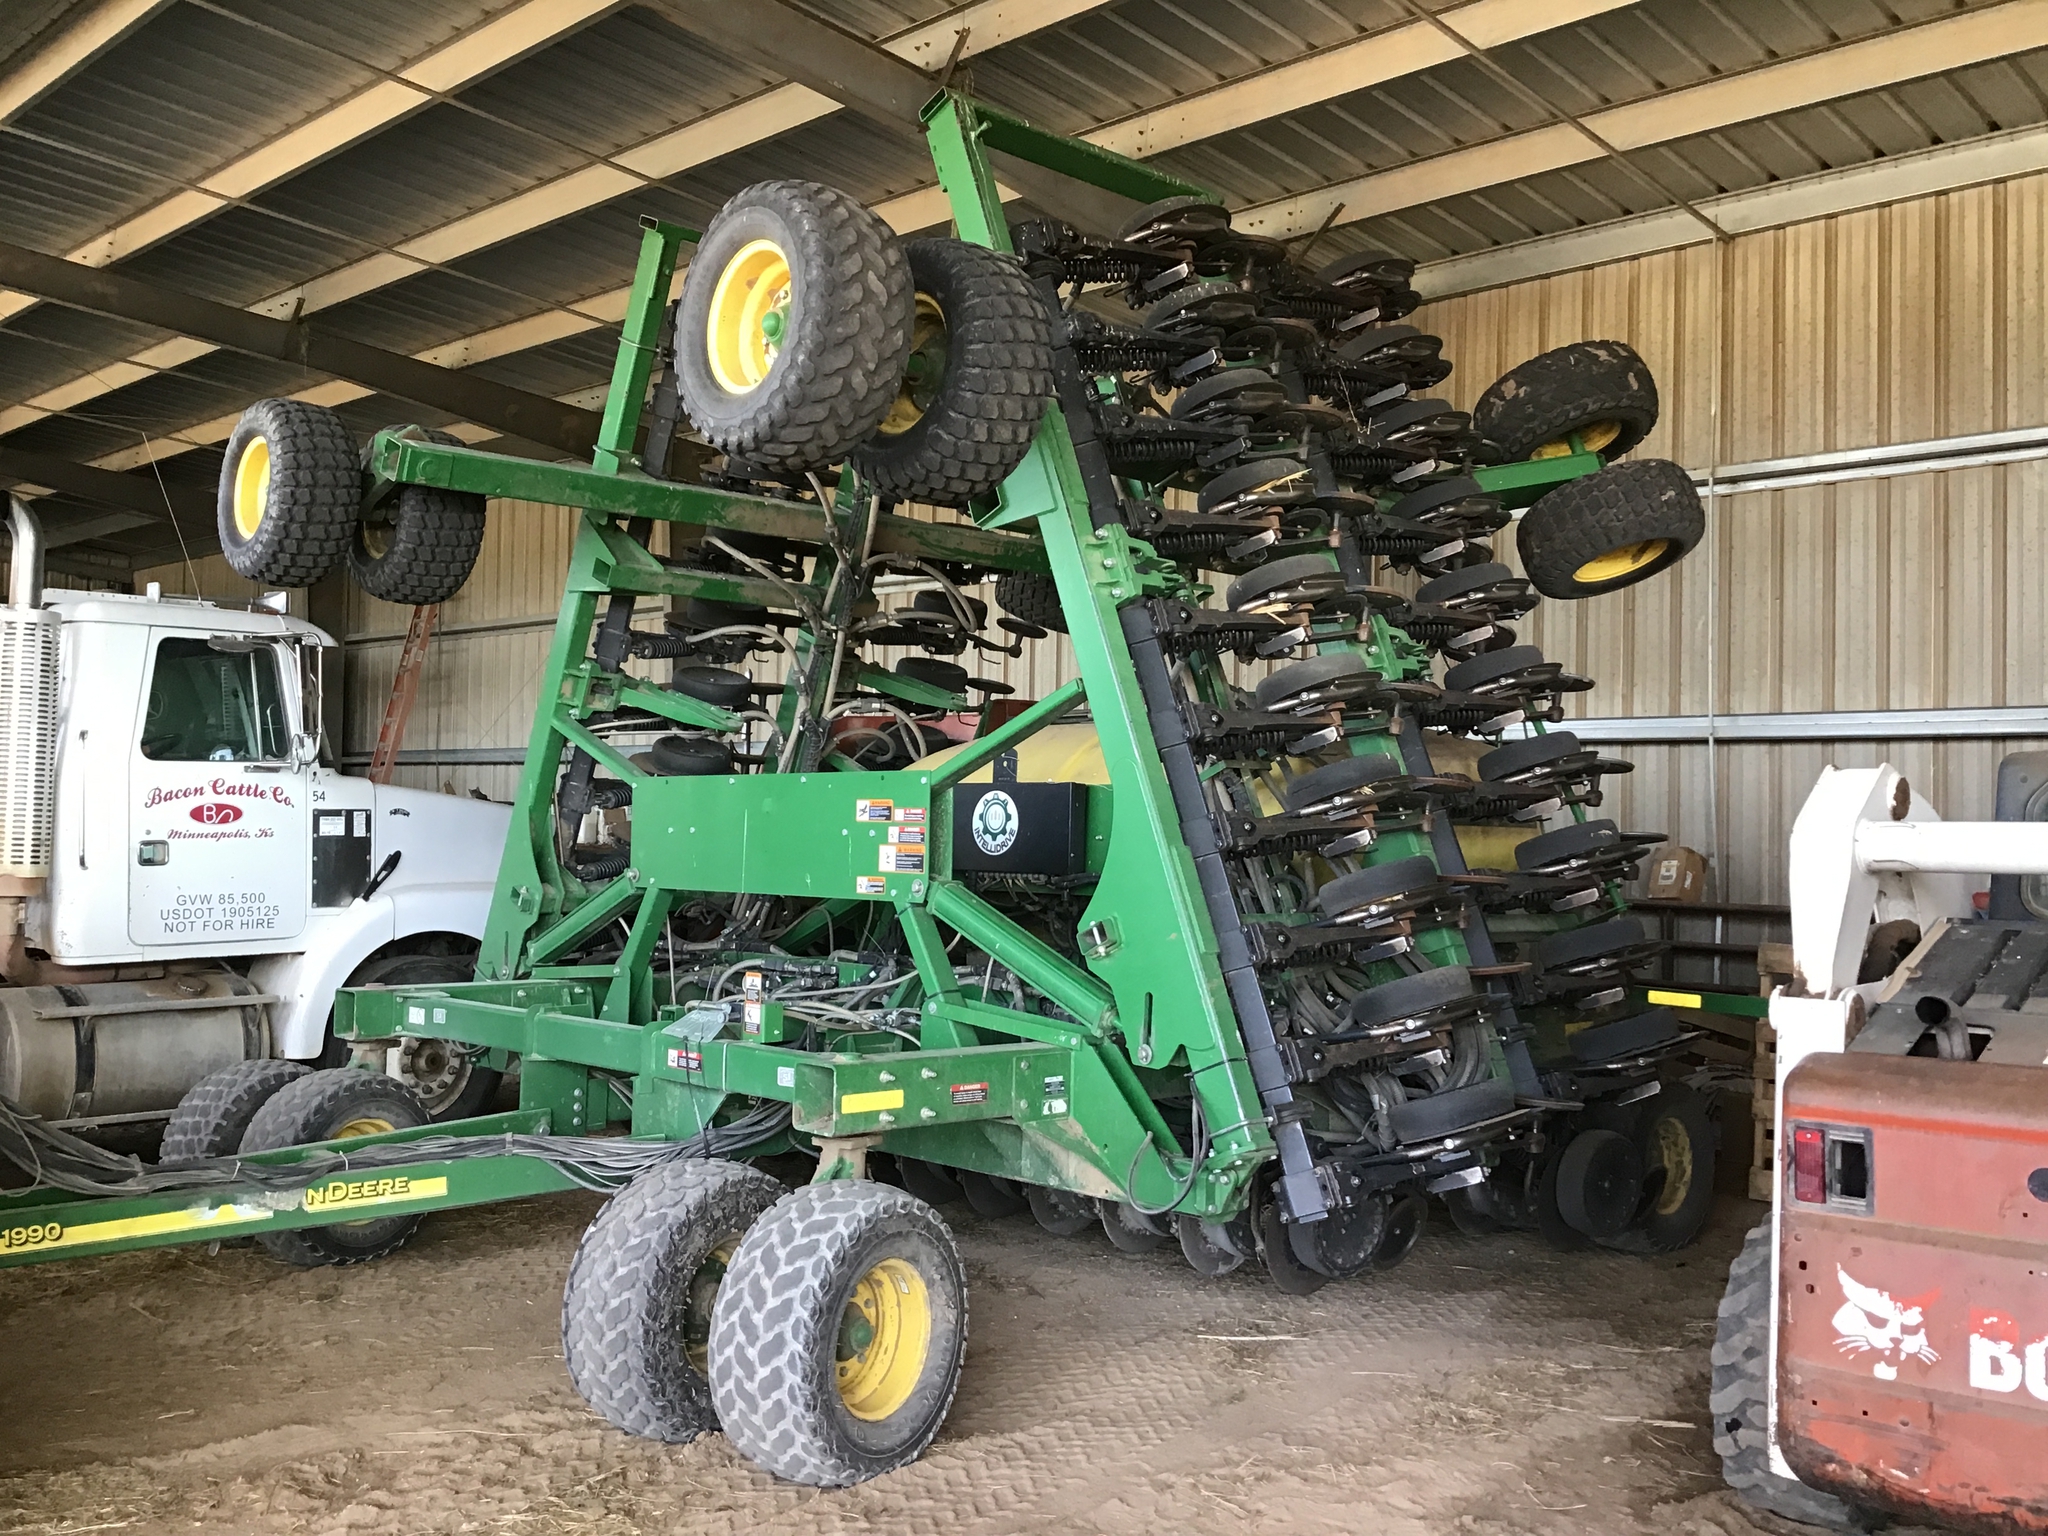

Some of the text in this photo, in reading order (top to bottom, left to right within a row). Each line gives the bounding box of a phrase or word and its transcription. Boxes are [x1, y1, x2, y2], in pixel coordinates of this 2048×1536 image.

[145, 786, 206, 808] Bacon
[208, 778, 268, 799] Cattle
[312, 790, 326, 802] 54
[167, 828, 275, 842] Minneapolis, Ks
[974, 827, 1016, 853] INTELLIDRIVE
[176, 892, 266, 906] GVW 85,500
[160, 905, 280, 920] USDOT 1905125
[164, 918, 276, 933] NOT FOR HIRE
[2, 1222, 63, 1248] 1990
